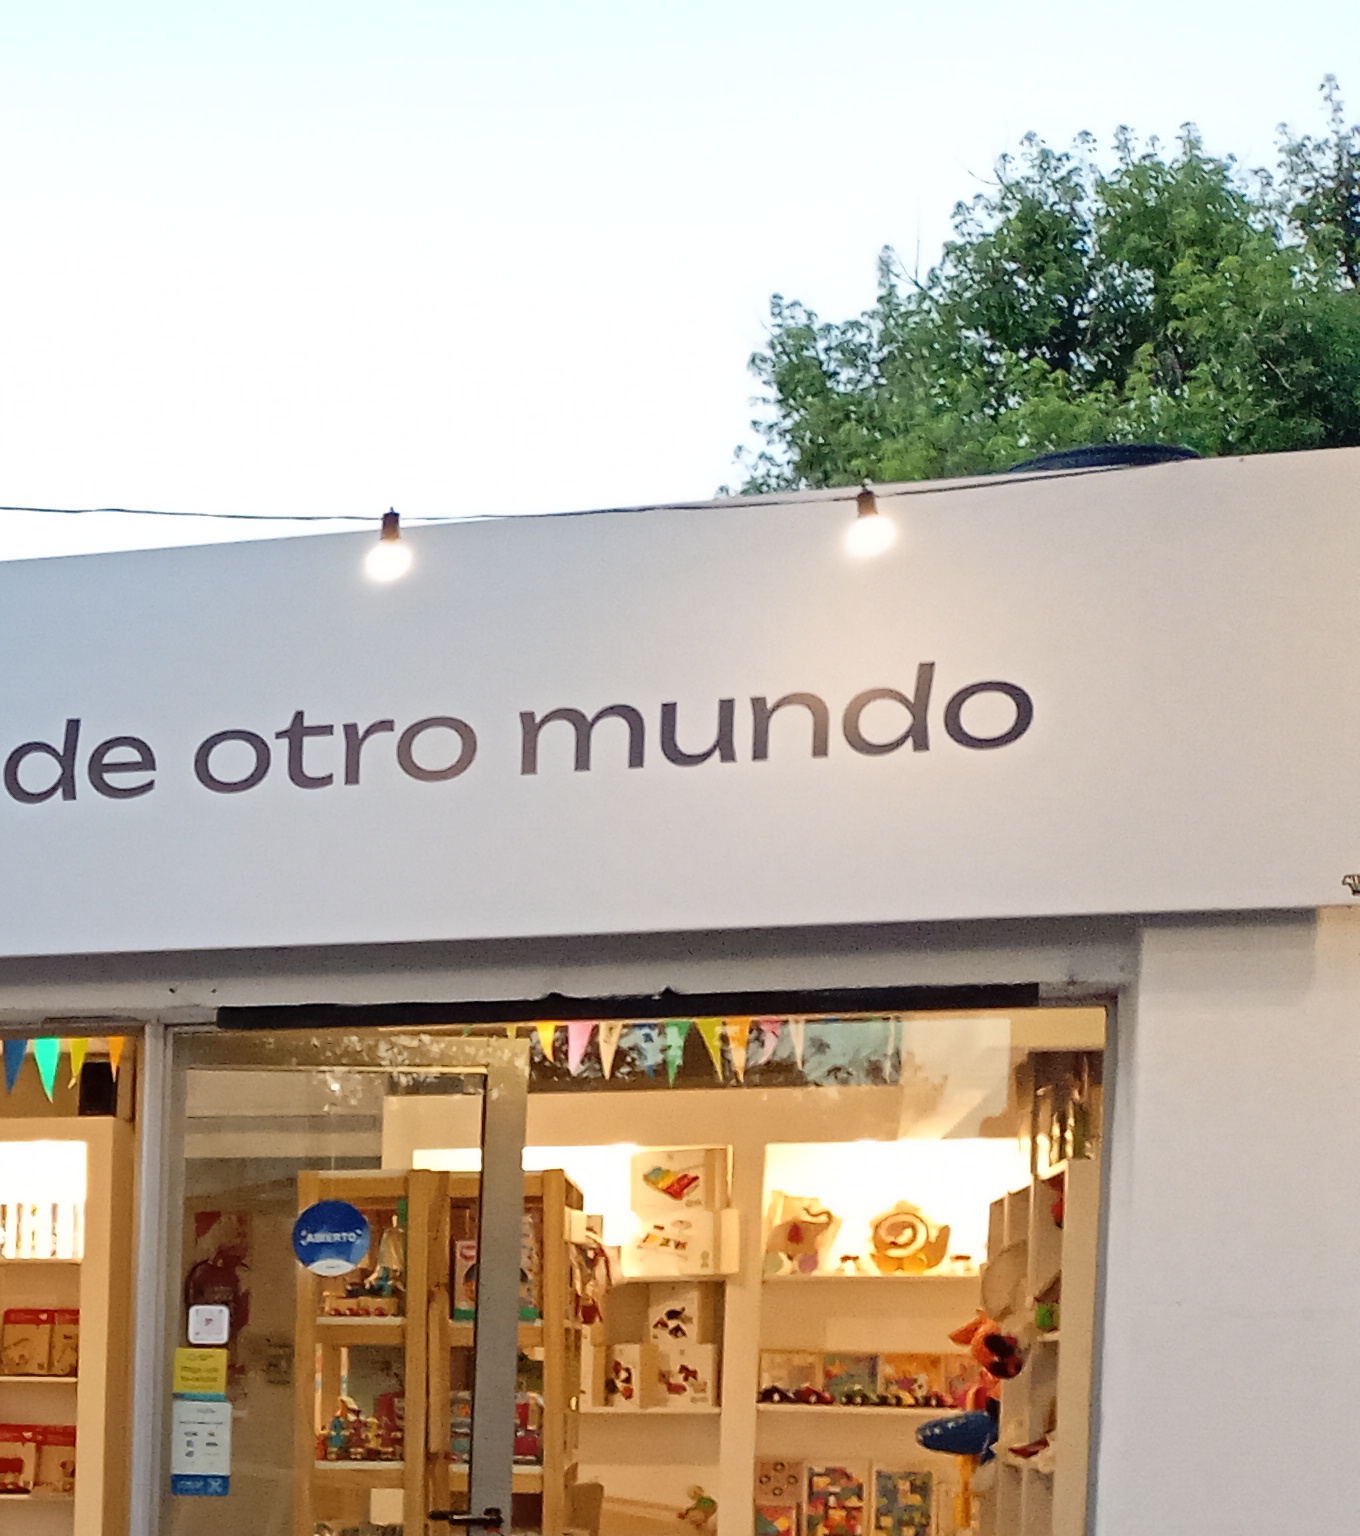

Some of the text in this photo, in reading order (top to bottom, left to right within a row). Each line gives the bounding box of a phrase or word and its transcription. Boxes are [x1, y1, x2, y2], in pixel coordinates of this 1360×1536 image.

[3, 718, 157, 804] de
[193, 709, 478, 794] otro
[519, 662, 1034, 776] mundo
